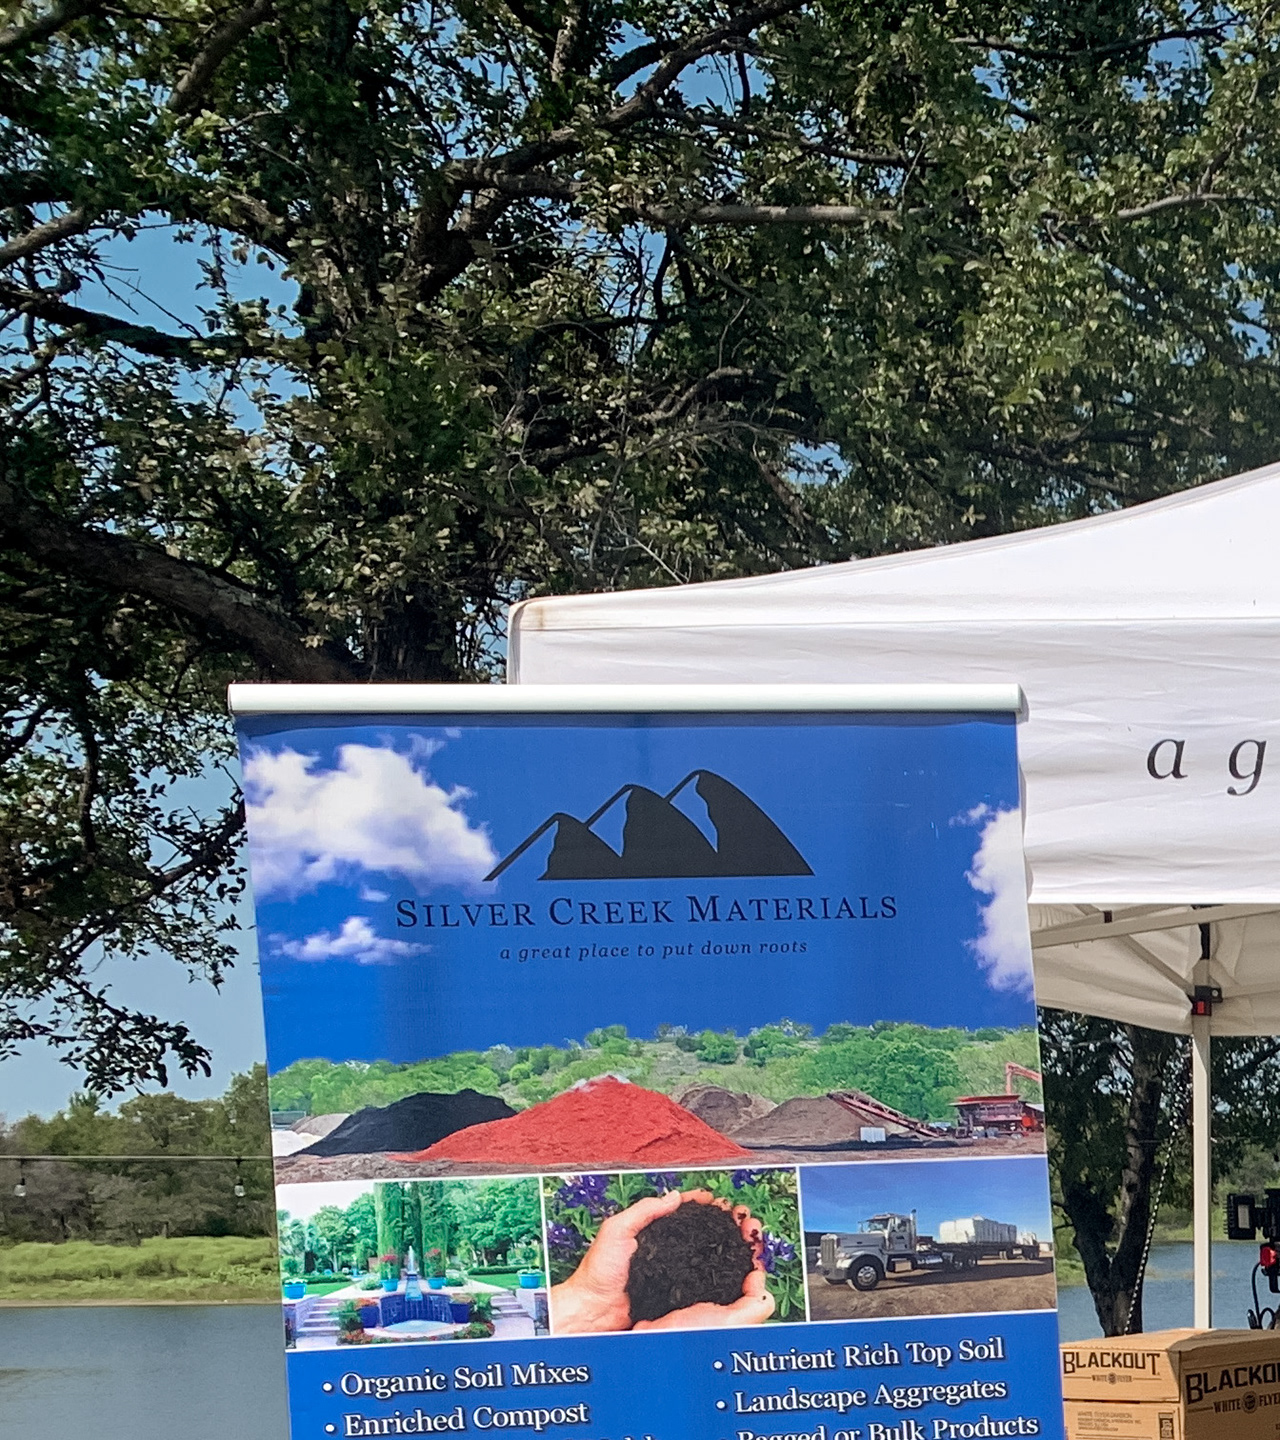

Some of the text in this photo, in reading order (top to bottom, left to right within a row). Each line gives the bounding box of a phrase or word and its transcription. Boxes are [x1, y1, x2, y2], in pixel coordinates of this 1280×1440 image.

[1146, 738, 1188, 781] a
[396, 895, 898, 928] SILVER CREEK MATERIALS
[500, 940, 808, 963] a great place to put down roots
[731, 1337, 1005, 1374] Nutrient Rich Top Soil
[1063, 1351, 1160, 1375] BLACKOUT
[340, 1362, 590, 1399] Organic Soil Mixes
[734, 1380, 1007, 1413] Landscape Aggregates
[344, 1403, 589, 1437] Enriched Compost
[1213, 1399, 1241, 1413] WHITE
[932, 1415, 1039, 1440] Products
